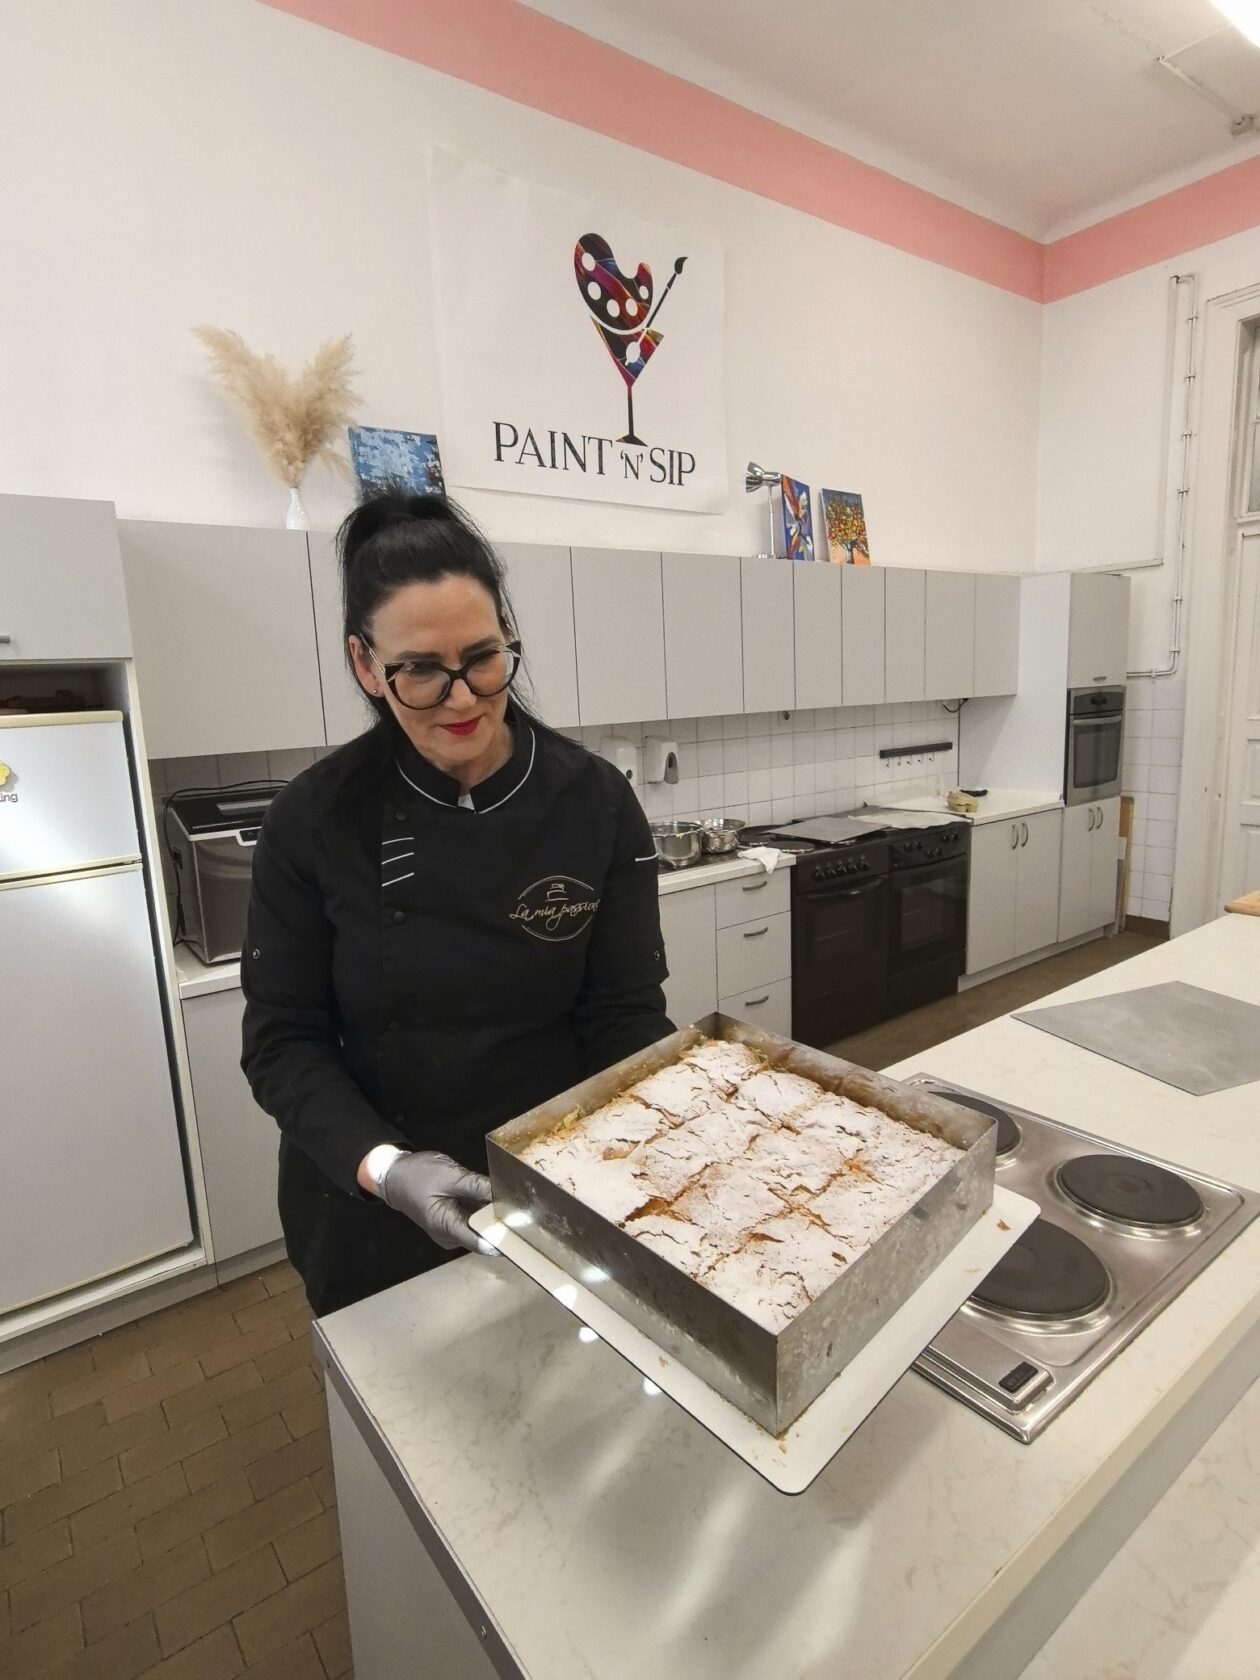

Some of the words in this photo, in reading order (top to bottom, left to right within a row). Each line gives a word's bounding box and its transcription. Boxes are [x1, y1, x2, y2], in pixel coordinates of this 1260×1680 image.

[493, 421, 613, 476] PAINT
[649, 447, 696, 486] SIP
[509, 903, 534, 921] La
